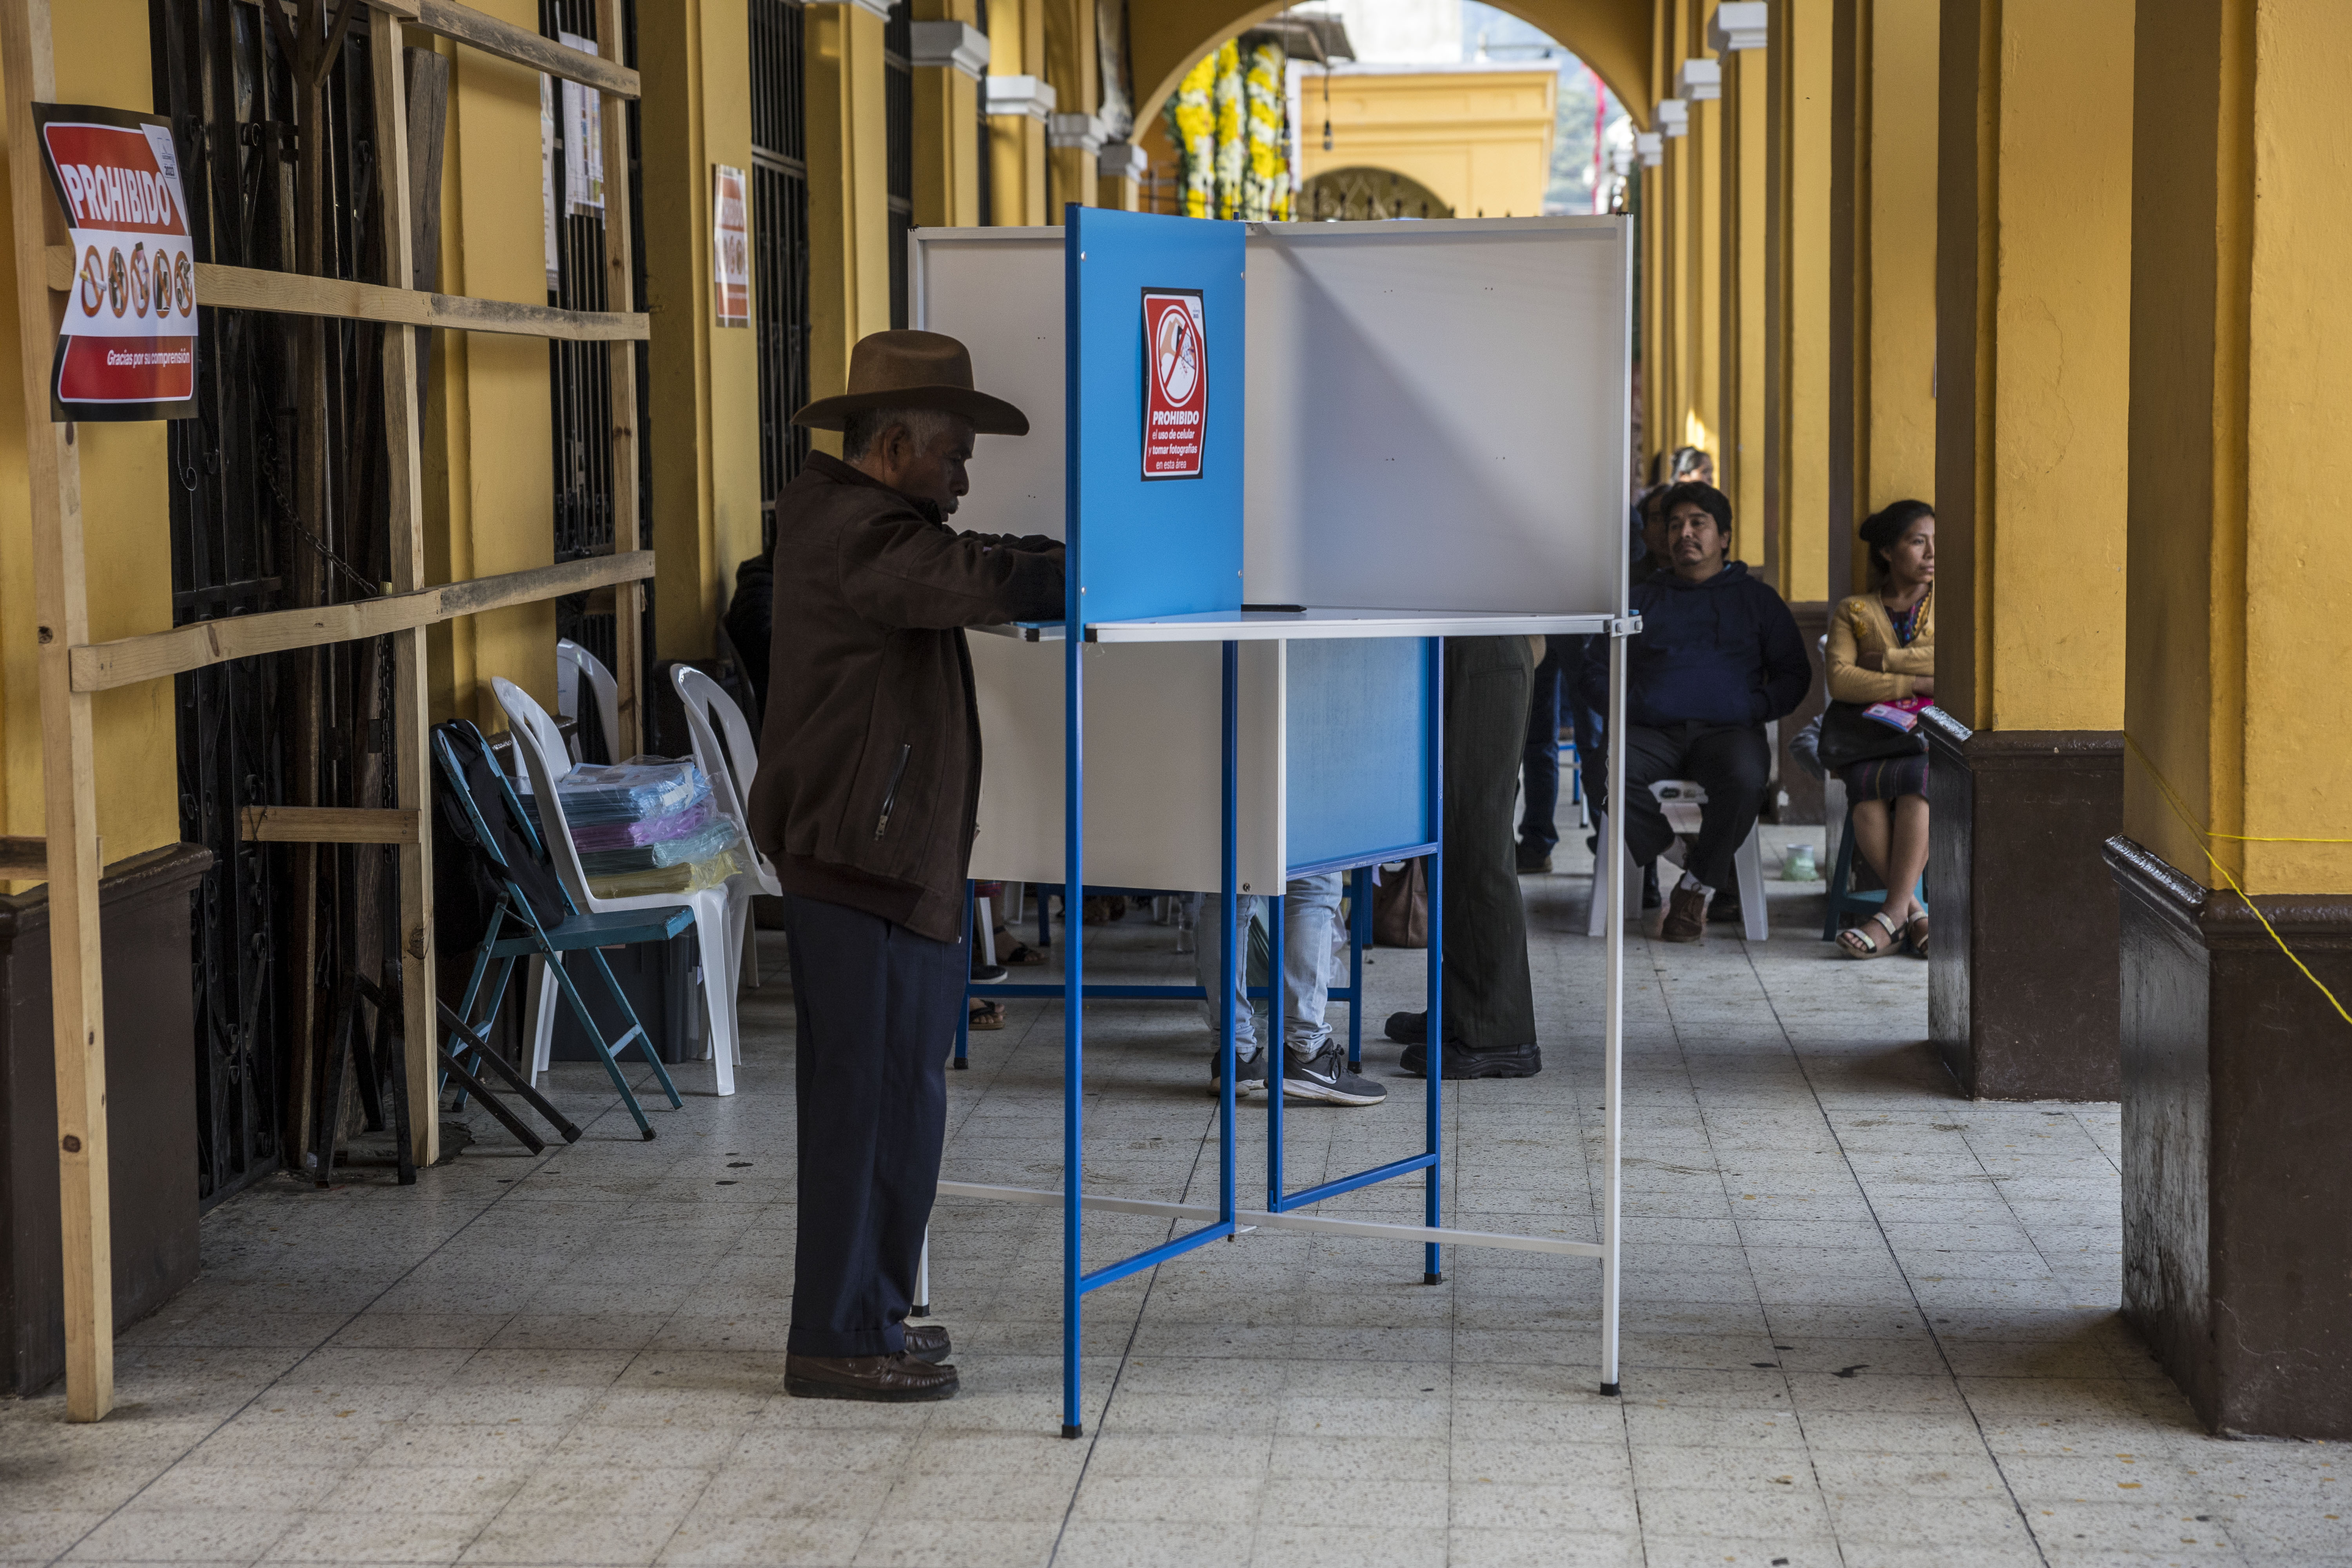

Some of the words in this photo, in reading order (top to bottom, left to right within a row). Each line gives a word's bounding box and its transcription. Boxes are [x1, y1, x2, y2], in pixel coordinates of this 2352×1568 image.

[60, 164, 171, 226] PROHIBIDO
[107, 349, 133, 366] Gracias
[132, 354, 144, 368] por
[144, 354, 151, 365] su
[151, 348, 190, 367] comprensión
[1152, 411, 1200, 425] PROHIBIDO
[1152, 429, 1158, 439] el
[1158, 431, 1168, 439] uso
[1169, 428, 1176, 439] de
[1176, 428, 1195, 439] celular
[1148, 447, 1152, 457] y
[1152, 445, 1169, 455] tomar
[1169, 443, 1197, 456] fotografías
[1156, 461, 1163, 470] en
[1164, 460, 1175, 469] esta
[1175, 458, 1187, 469] área
